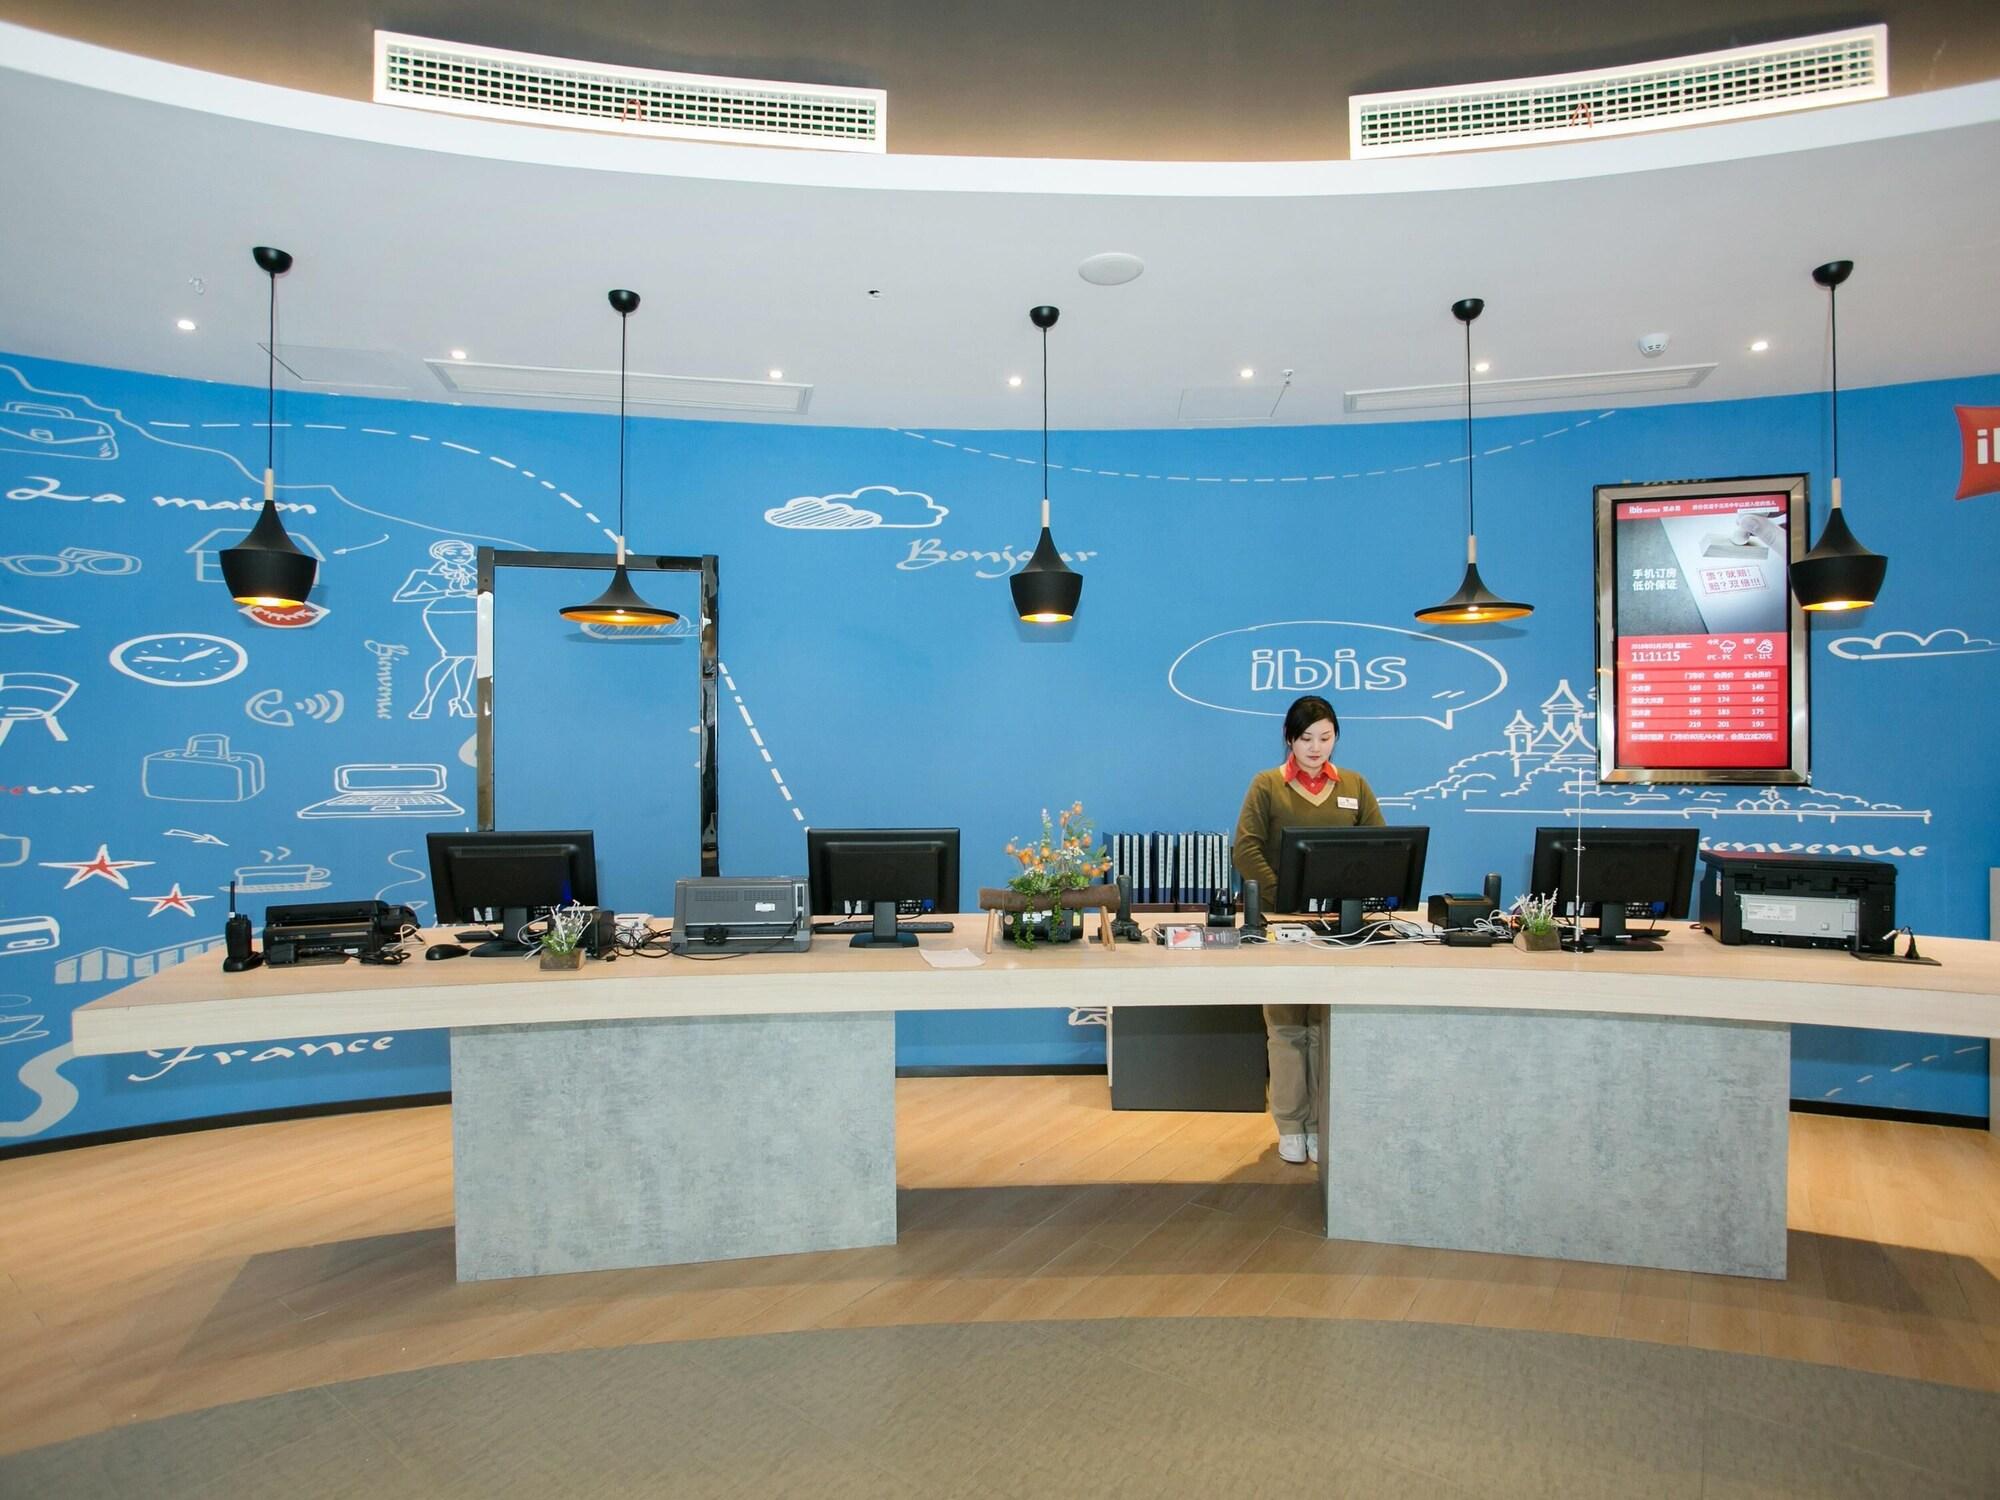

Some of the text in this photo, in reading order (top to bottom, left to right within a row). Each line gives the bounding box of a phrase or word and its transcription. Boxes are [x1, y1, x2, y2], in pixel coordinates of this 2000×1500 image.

[6, 476, 126, 503] La
[1632, 568, 1677, 580] 手机订房
[1632, 579, 1679, 591] 低价保证
[1631, 650, 1681, 662] 11:11:15
[1250, 648, 1407, 692] ibis
[0, 785, 96, 795] eux
[1699, 836, 1928, 858] ienvenue
[127, 1036, 395, 1082] France
